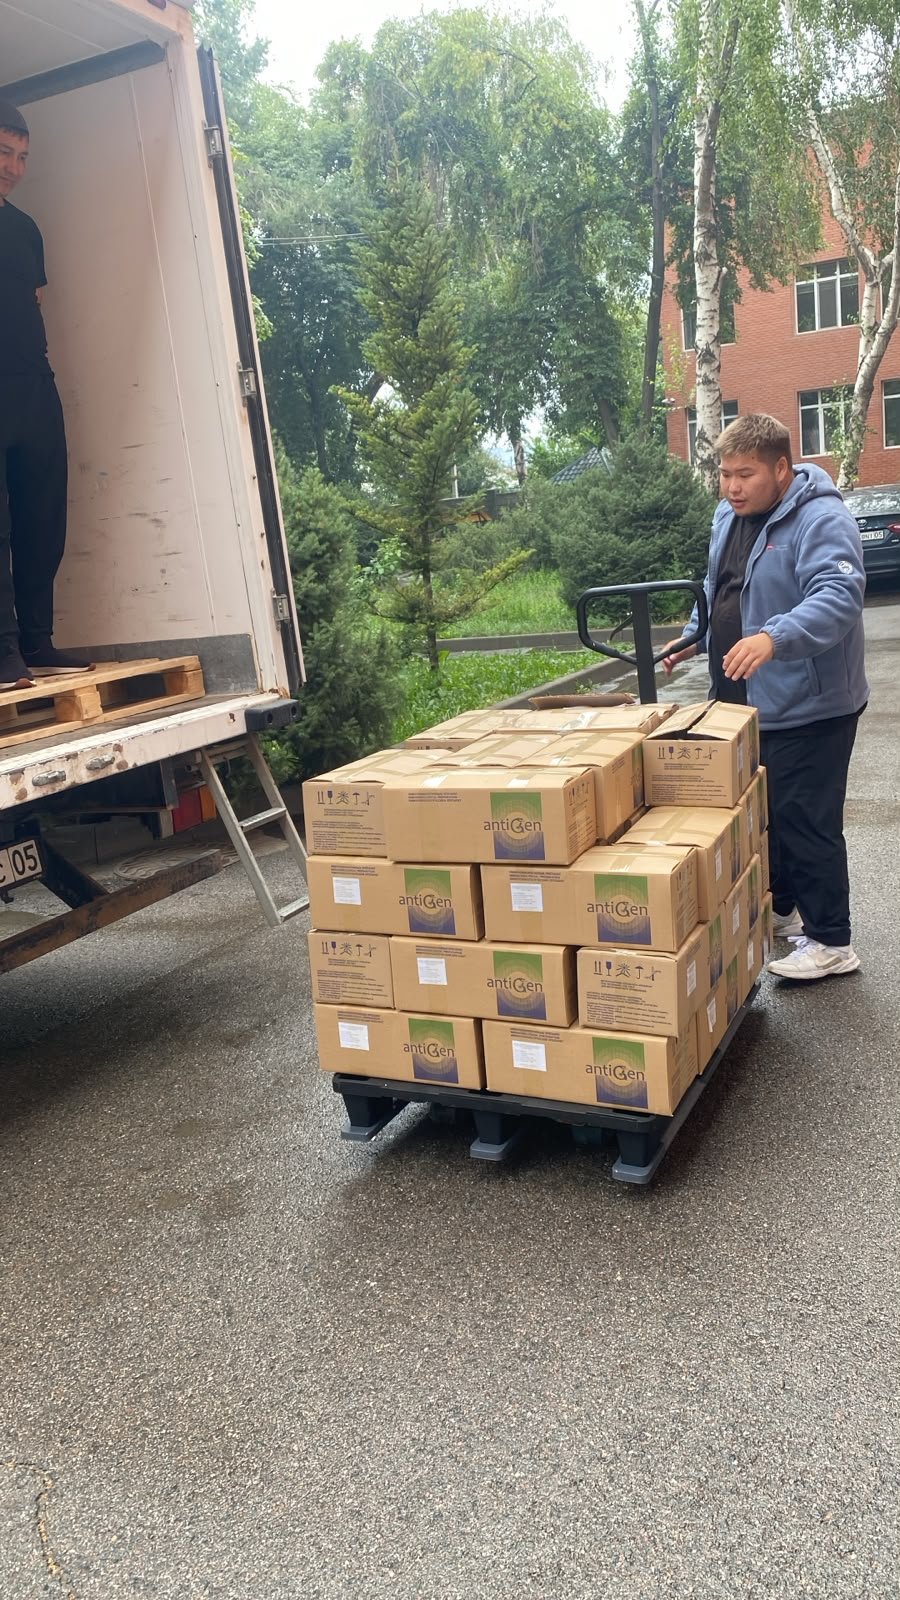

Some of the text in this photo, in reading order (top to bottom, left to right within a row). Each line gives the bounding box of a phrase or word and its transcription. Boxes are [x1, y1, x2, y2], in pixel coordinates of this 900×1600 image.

[483, 818, 542, 834] antiGen
[12, 844, 38, 876] 05
[399, 894, 452, 909] antiGen
[586, 901, 649, 917] antiGen
[487, 977, 543, 993] antiGen
[403, 1043, 455, 1058] antiGen
[585, 1063, 645, 1081] antiGen
